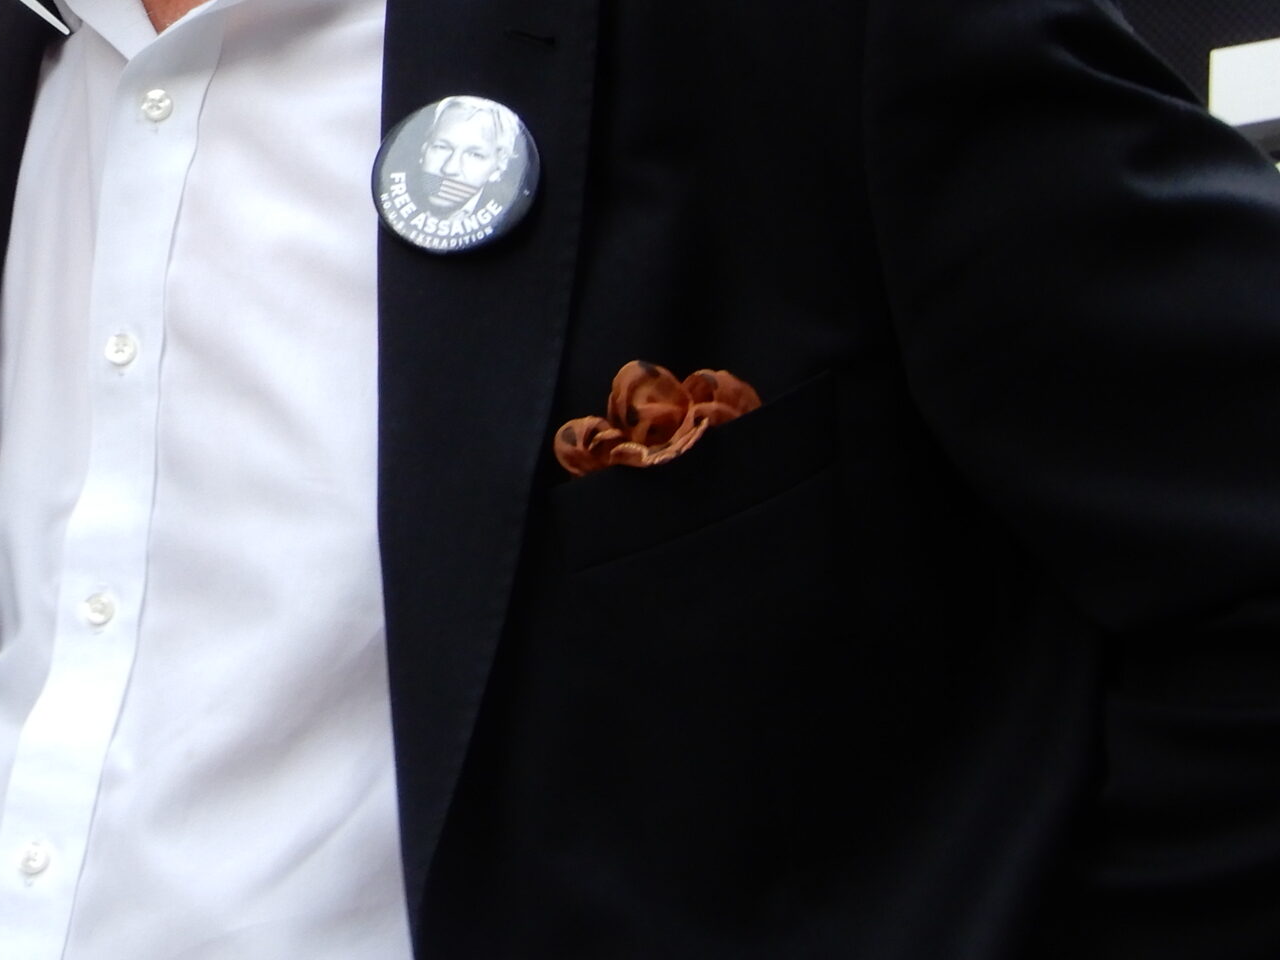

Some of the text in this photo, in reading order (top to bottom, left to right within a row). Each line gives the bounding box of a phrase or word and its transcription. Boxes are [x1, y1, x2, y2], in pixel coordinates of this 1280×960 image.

[380, 192, 392, 210] NO
[409, 225, 494, 248] EXTRADITION
[390, 172, 503, 237] FREE ASSANGE
